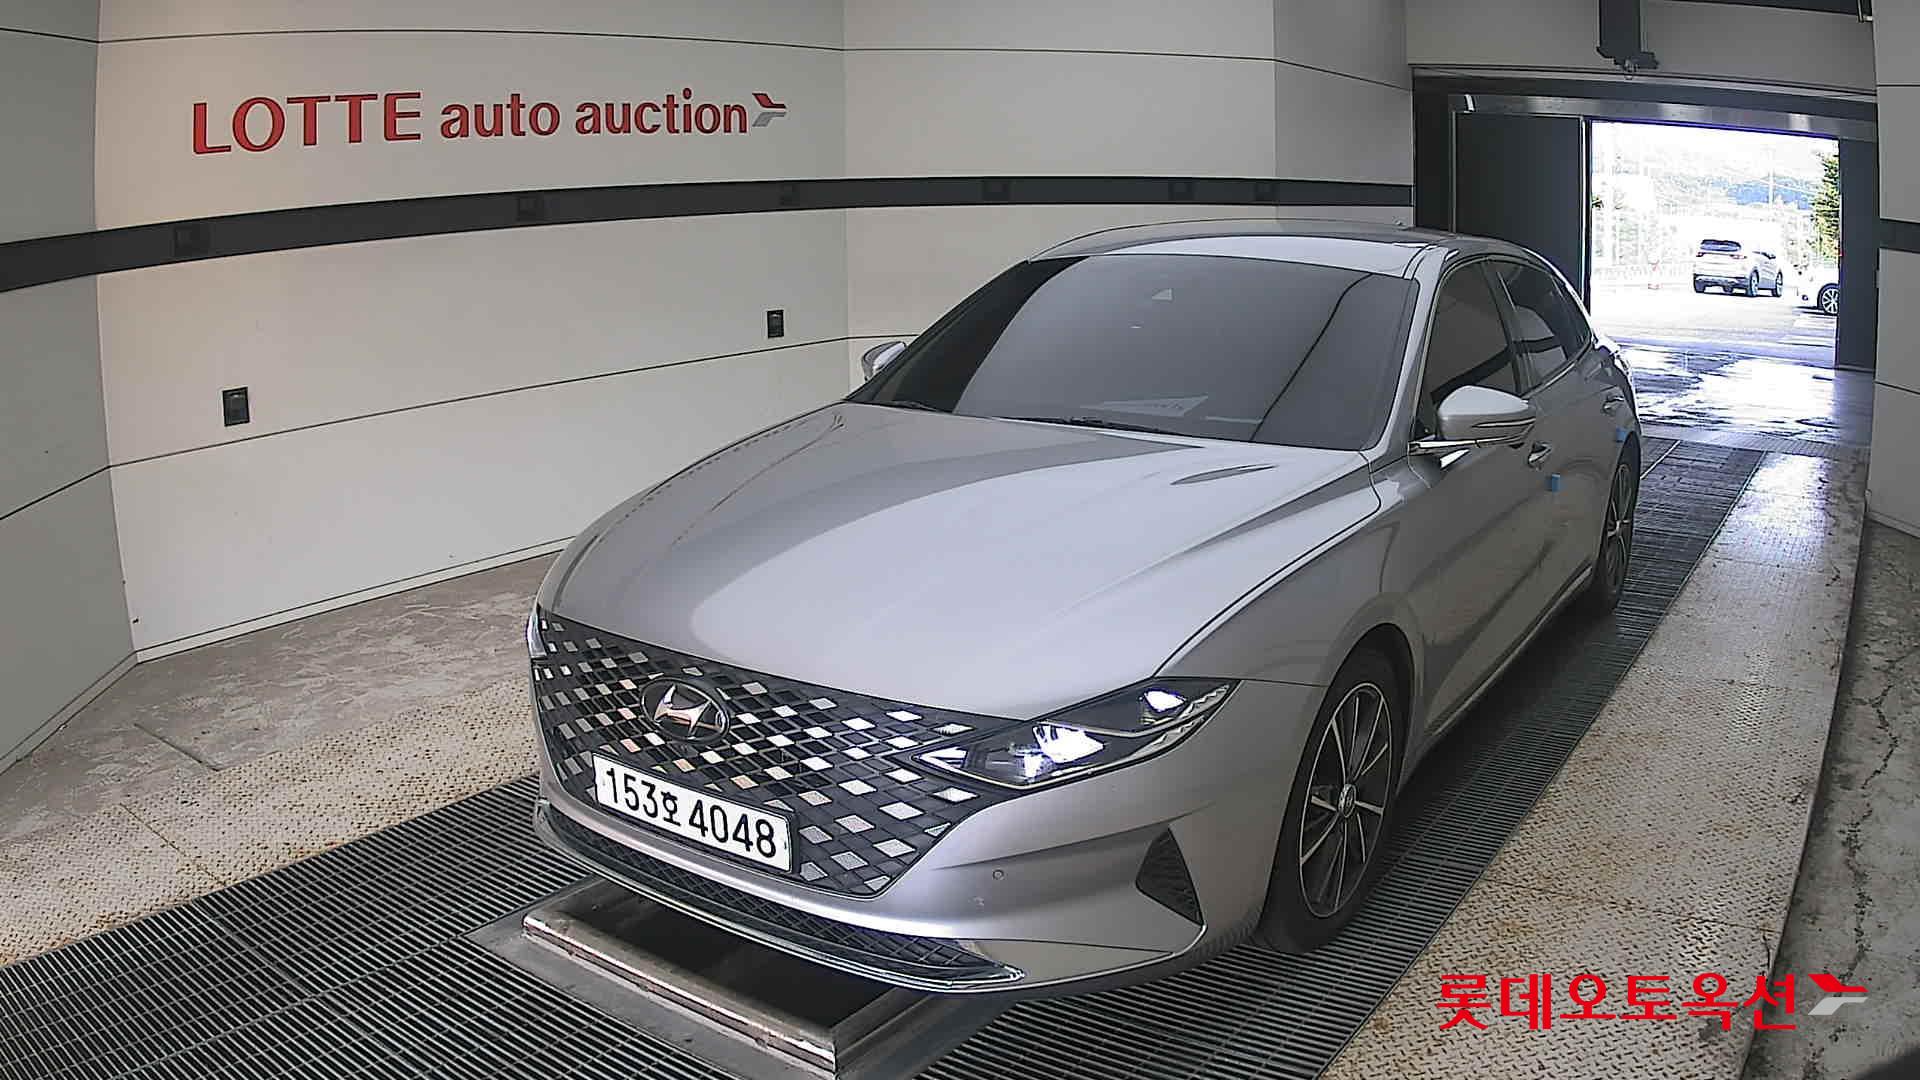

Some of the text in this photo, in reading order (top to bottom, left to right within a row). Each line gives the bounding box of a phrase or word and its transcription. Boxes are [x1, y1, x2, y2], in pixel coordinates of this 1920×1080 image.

[193, 87, 748, 154] LOTTE auto auction
[688, 799, 777, 858] 4048
